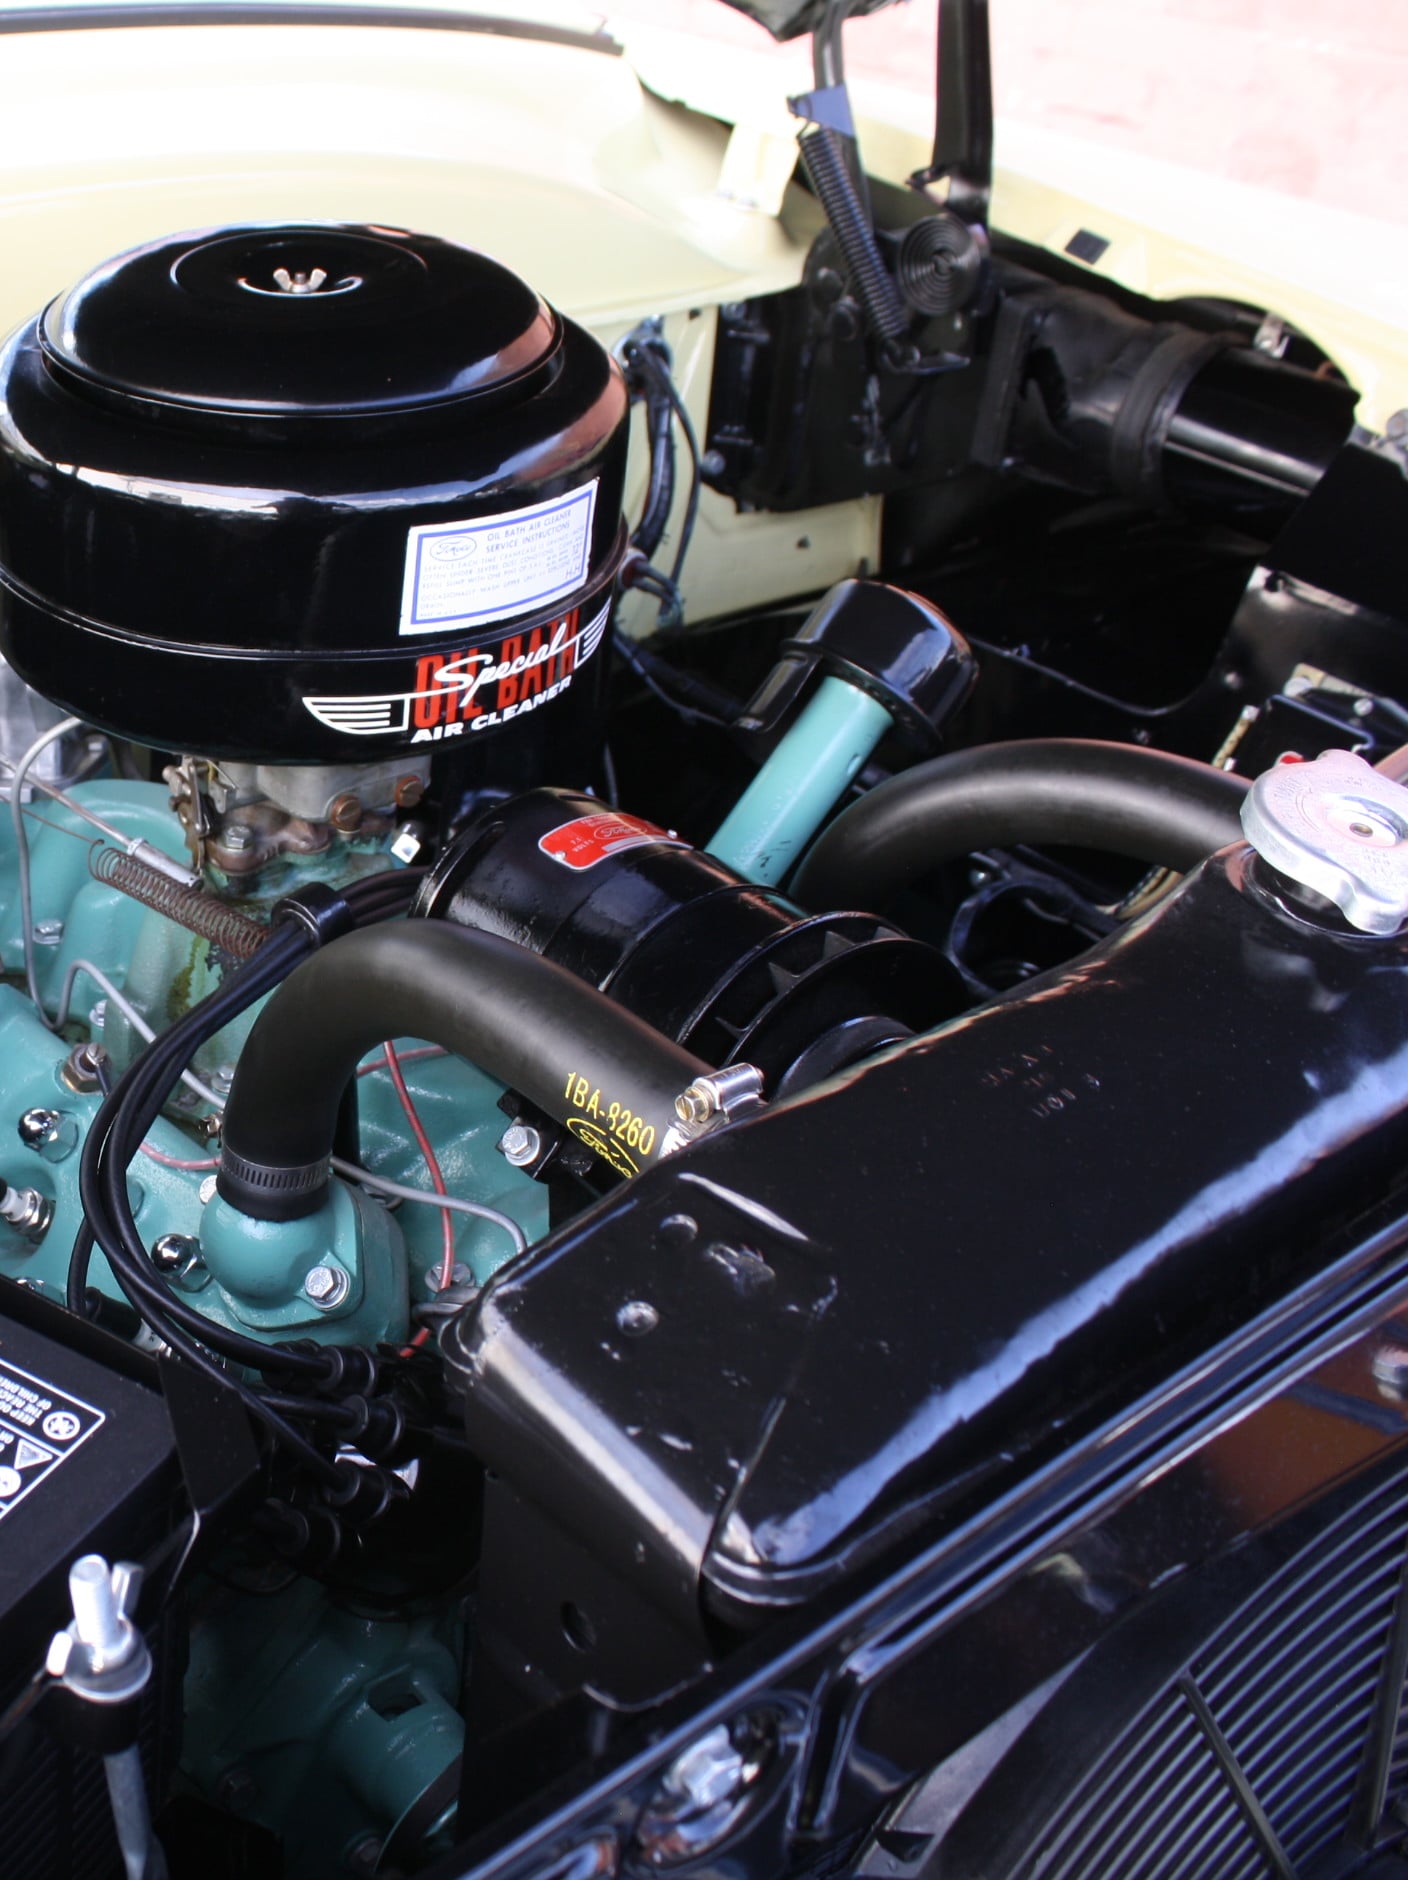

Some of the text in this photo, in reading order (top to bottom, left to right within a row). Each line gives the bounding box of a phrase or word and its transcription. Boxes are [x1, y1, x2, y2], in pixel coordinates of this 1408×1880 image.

[411, 675, 573, 743] AIR CLEANER
[564, 1071, 656, 1156] 1BA-8260
